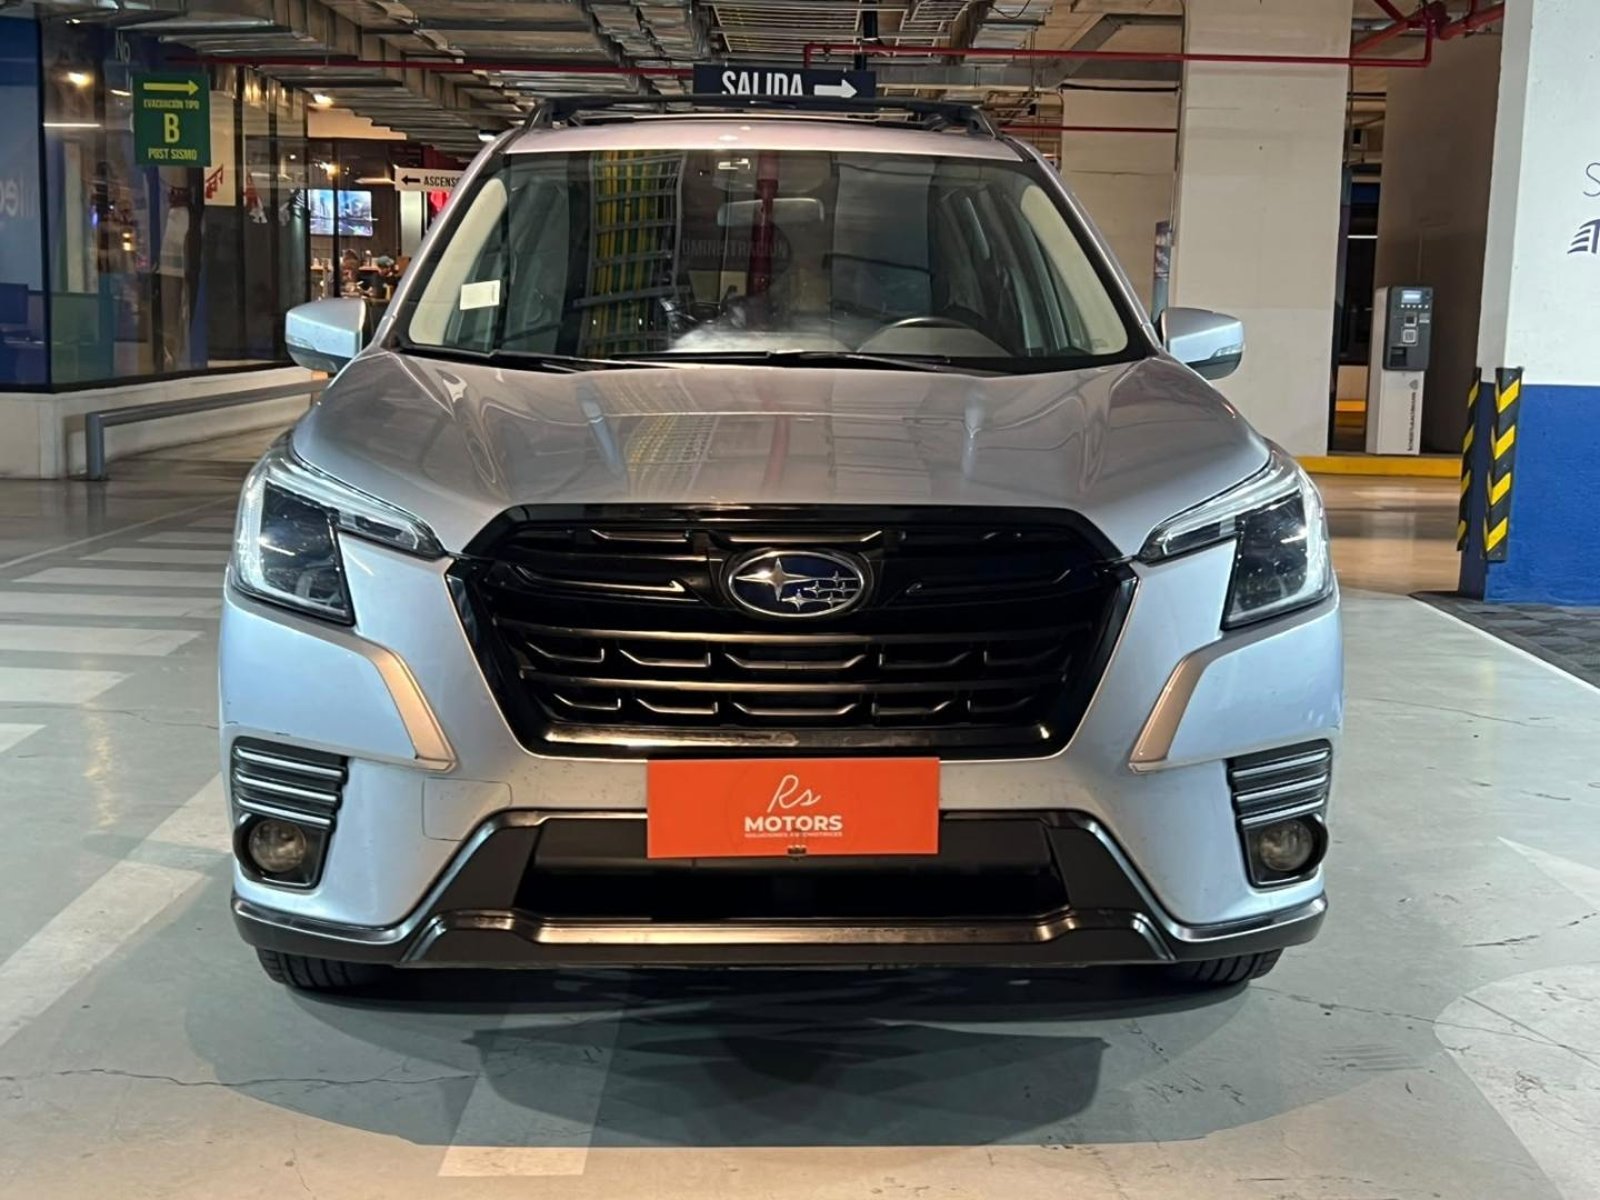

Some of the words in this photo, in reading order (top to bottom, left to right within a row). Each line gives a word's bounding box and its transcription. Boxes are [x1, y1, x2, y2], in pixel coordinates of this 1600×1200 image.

[722, 71, 803, 95] SALIDA
[164, 113, 180, 143] B
[148, 148, 169, 160] POST
[171, 149, 198, 160] SISMO
[767, 774, 821, 813] Rs
[744, 815, 843, 832] MOTORS
